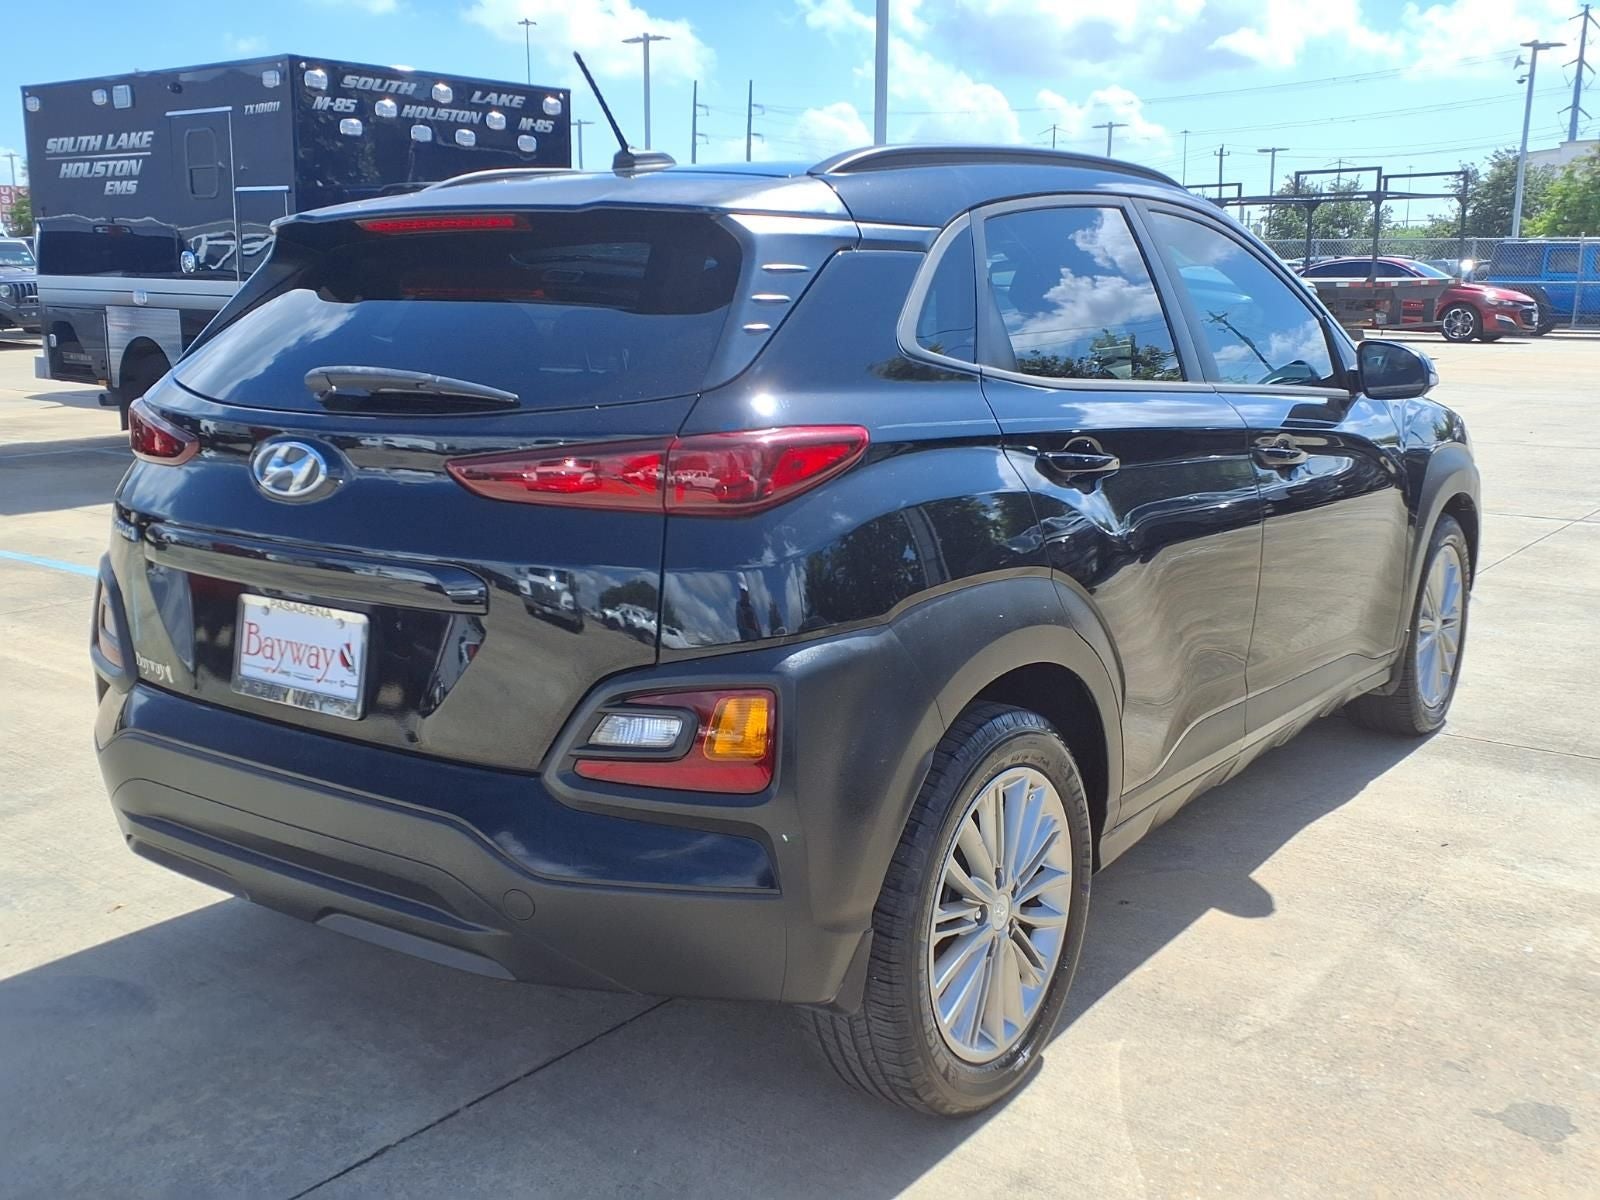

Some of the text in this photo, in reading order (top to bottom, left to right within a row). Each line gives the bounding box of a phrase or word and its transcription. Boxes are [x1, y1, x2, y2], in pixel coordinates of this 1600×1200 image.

[340, 75, 526, 109] SOUTH LAKE
[312, 95, 358, 113] M-85
[400, 104, 483, 125] HOUSTON
[517, 117, 555, 133] M-85
[45, 130, 154, 154] SOUTH LAKE
[59, 159, 143, 179] HOUSTON
[104, 180, 139, 196] EMS
[269, 599, 334, 619] PASADENA
[244, 621, 336, 684] Bayway
